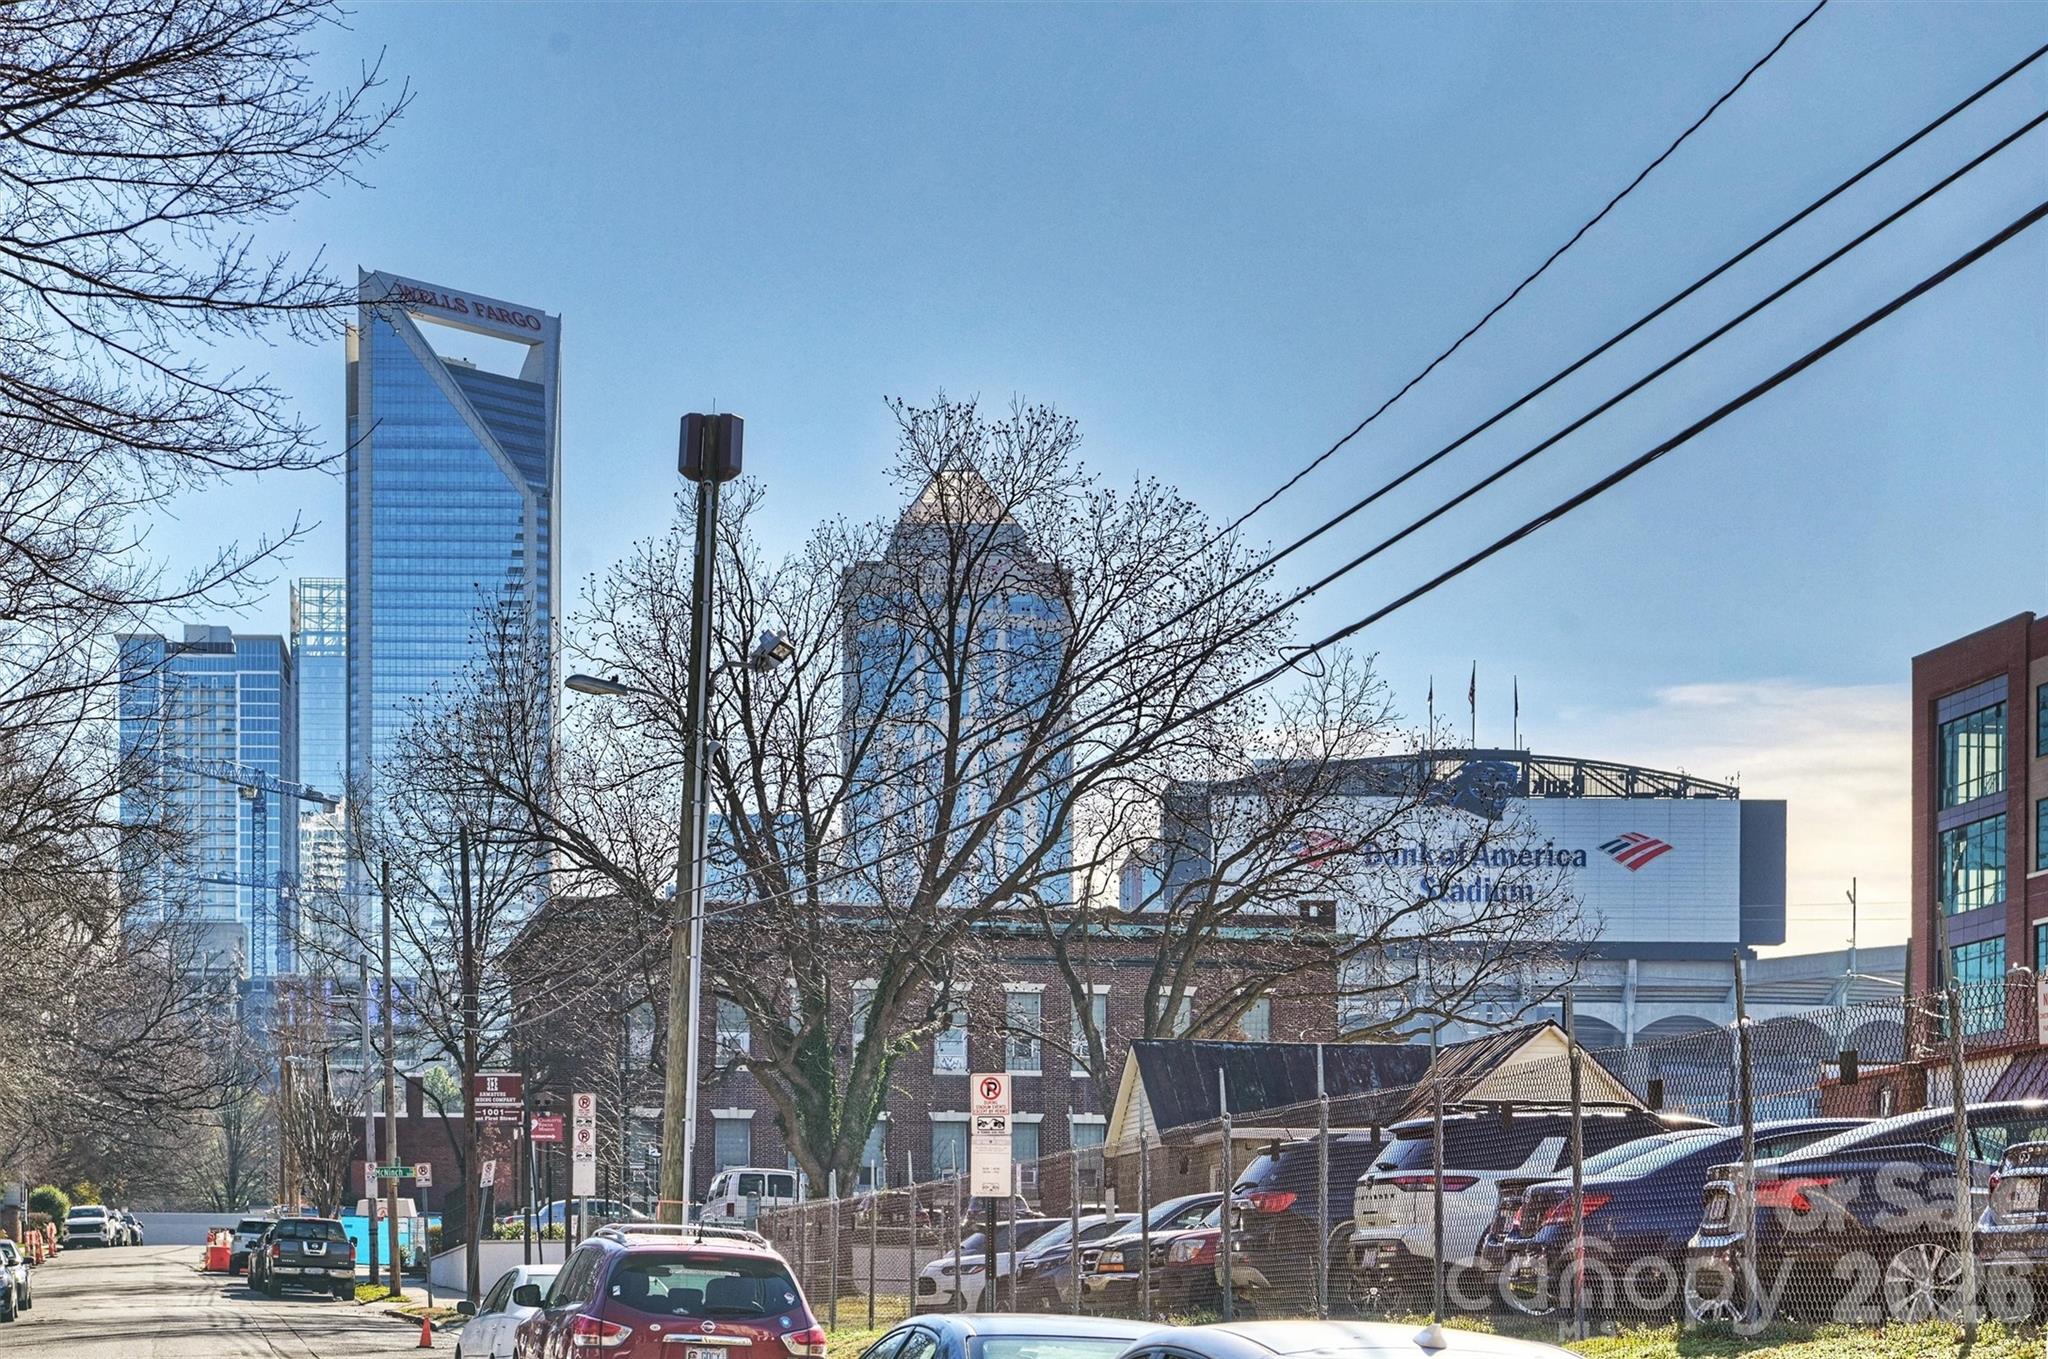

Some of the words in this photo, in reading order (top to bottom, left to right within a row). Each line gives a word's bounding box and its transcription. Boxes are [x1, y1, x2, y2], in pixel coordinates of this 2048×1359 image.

[398, 284, 469, 314] WELLS
[472, 301, 542, 331] FARGO
[1365, 844, 1432, 868] Bank
[1439, 842, 1468, 868] of
[1472, 844, 1587, 868] America
